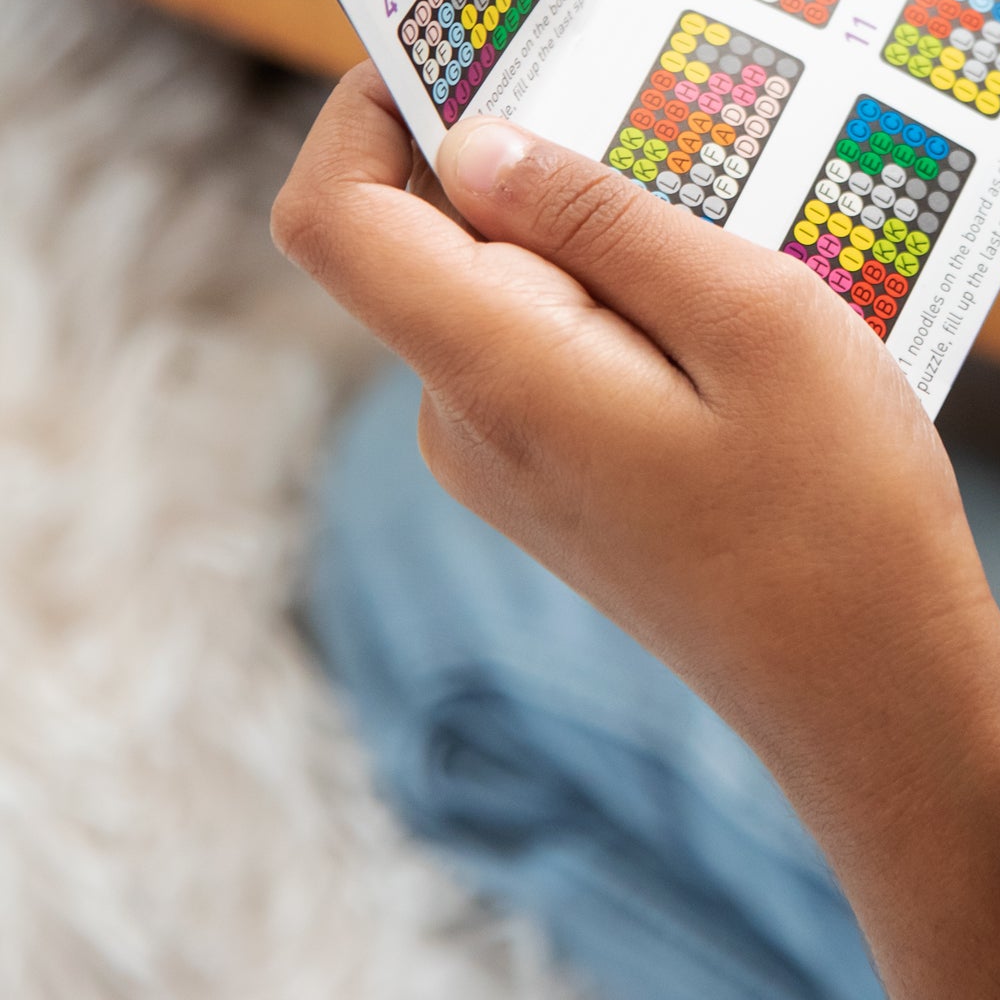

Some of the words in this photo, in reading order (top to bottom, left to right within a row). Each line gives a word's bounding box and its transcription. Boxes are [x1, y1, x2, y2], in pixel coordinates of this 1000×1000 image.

[844, 17, 875, 46] 11
[512, 78, 528, 101] fill
[526, 61, 539, 81] up
[553, 10, 573, 38] last
[485, 57, 520, 111] noodles
[521, 39, 533, 58] on
[744, 68, 763, 83] H
[612, 151, 630, 166] K
[622, 131, 641, 146] K
[632, 112, 651, 127] B
[643, 92, 662, 107] B
[653, 73, 672, 88] B
[665, 57, 681, 65] I
[685, 20, 701, 28] I
[734, 87, 753, 103] H
[635, 162, 654, 177] K
[646, 143, 664, 158] K
[656, 123, 675, 138] B
[666, 103, 685, 119] B
[677, 83, 695, 99] H
[689, 68, 704, 76] I
[709, 30, 724, 38] I
[723, 107, 742, 123] D
[882, 115, 900, 130] C
[658, 180, 678, 190] L
[671, 157, 689, 170] A
[681, 137, 700, 151] A
[692, 118, 710, 131] A
[701, 95, 719, 111] H
[711, 76, 729, 91] H
[715, 129, 733, 143] A
[705, 206, 724, 215] L
[715, 178, 731, 195] F
[726, 158, 742, 175] F
[736, 139, 754, 155] D
[746, 119, 765, 135] D
[756, 99, 775, 115] D
[766, 80, 785, 96] D
[872, 135, 890, 151] E
[703, 146, 718, 162] F
[798, 227, 814, 237] I
[809, 207, 825, 217] I
[818, 183, 833, 199] F
[828, 162, 843, 179] F
[839, 143, 857, 158] E
[849, 122, 867, 138] C
[860, 102, 877, 118] C
[862, 155, 879, 171] E
[692, 172, 712, 182] L
[851, 182, 869, 191] L
[682, 193, 701, 202] L
[840, 195, 856, 212] F
[831, 271, 848, 288] H
[843, 254, 859, 264] I
[854, 233, 870, 243] I
[863, 215, 882, 225] L
[874, 194, 892, 204] L
[884, 174, 903, 184] L
[895, 148, 912, 163] E
[905, 127, 923, 143] C
[831, 220, 847, 230] I
[853, 285, 871, 302] B
[863, 264, 882, 281] B
[875, 243, 893, 259] K
[886, 222, 903, 238] K
[896, 207, 915, 217] L
[917, 161, 935, 176] E
[927, 139, 945, 155] C
[819, 237, 837, 254] H
[813, 258, 826, 275] H
[907, 295, 944, 356] noodles
[939, 272, 955, 292] on
[948, 245, 969, 269] the
[961, 196, 992, 242] board
[916, 341, 952, 394] puzzle,
[942, 311, 963, 335] fill
[957, 291, 975, 310] up
[966, 263, 988, 288] the
